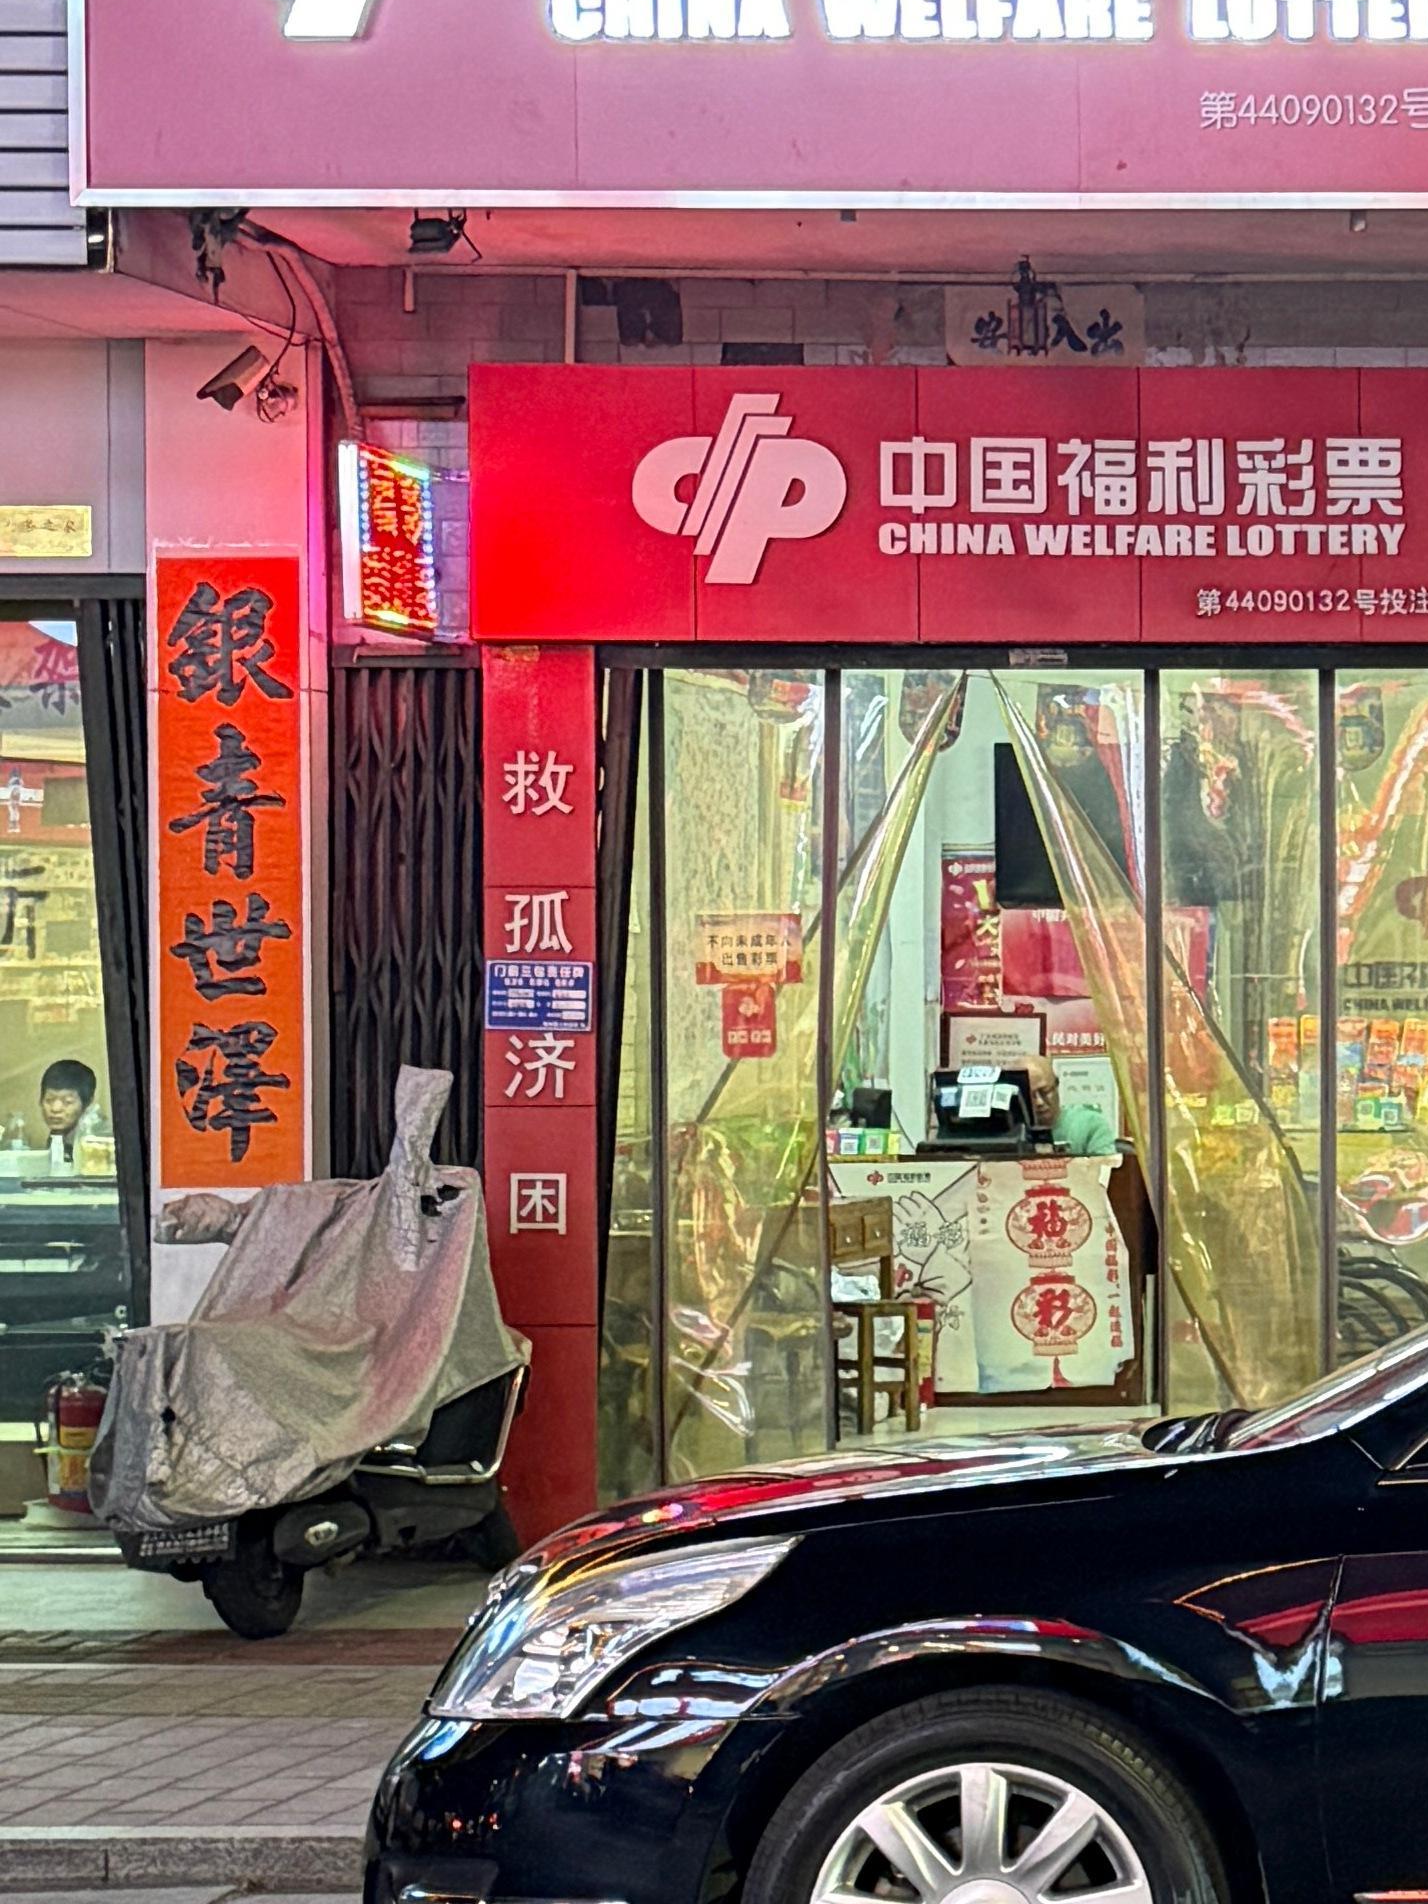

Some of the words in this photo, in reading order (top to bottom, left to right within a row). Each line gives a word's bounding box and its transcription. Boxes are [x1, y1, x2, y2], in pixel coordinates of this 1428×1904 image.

[879, 435, 1403, 516] 中国福利彩票
[878, 523, 1015, 556] CHINA
[1025, 523, 1217, 557] WELFARE
[1226, 523, 1406, 557] LOTTERY
[166, 581, 293, 1164] 銀青世澤
[707, 934, 792, 949] 不向未成年人
[721, 952, 778, 967] 出售彩票
[502, 749, 577, 1236] 救孤济困
